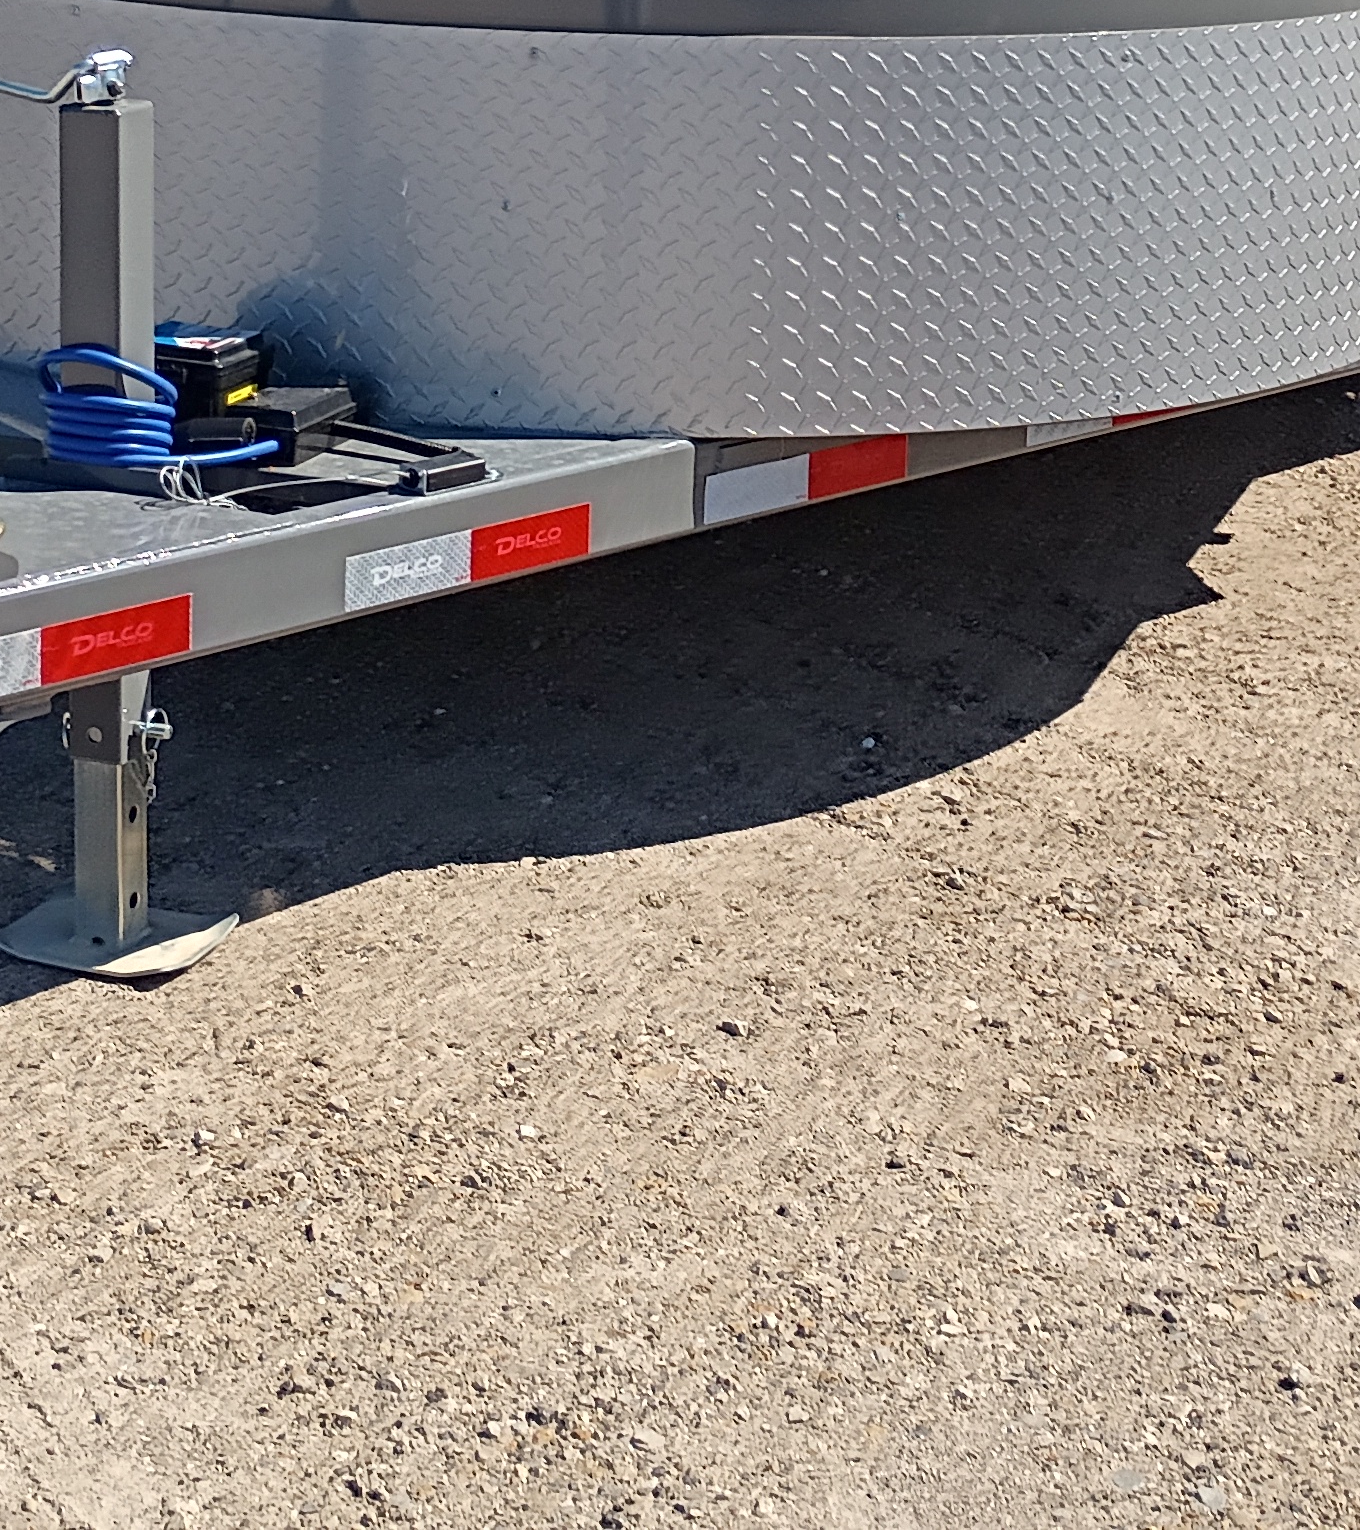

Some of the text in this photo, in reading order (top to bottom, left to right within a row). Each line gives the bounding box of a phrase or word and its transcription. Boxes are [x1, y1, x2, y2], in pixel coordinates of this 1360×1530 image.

[495, 526, 562, 555] DELCO
[370, 554, 442, 586] DELCO
[70, 622, 153, 657] DELCO
